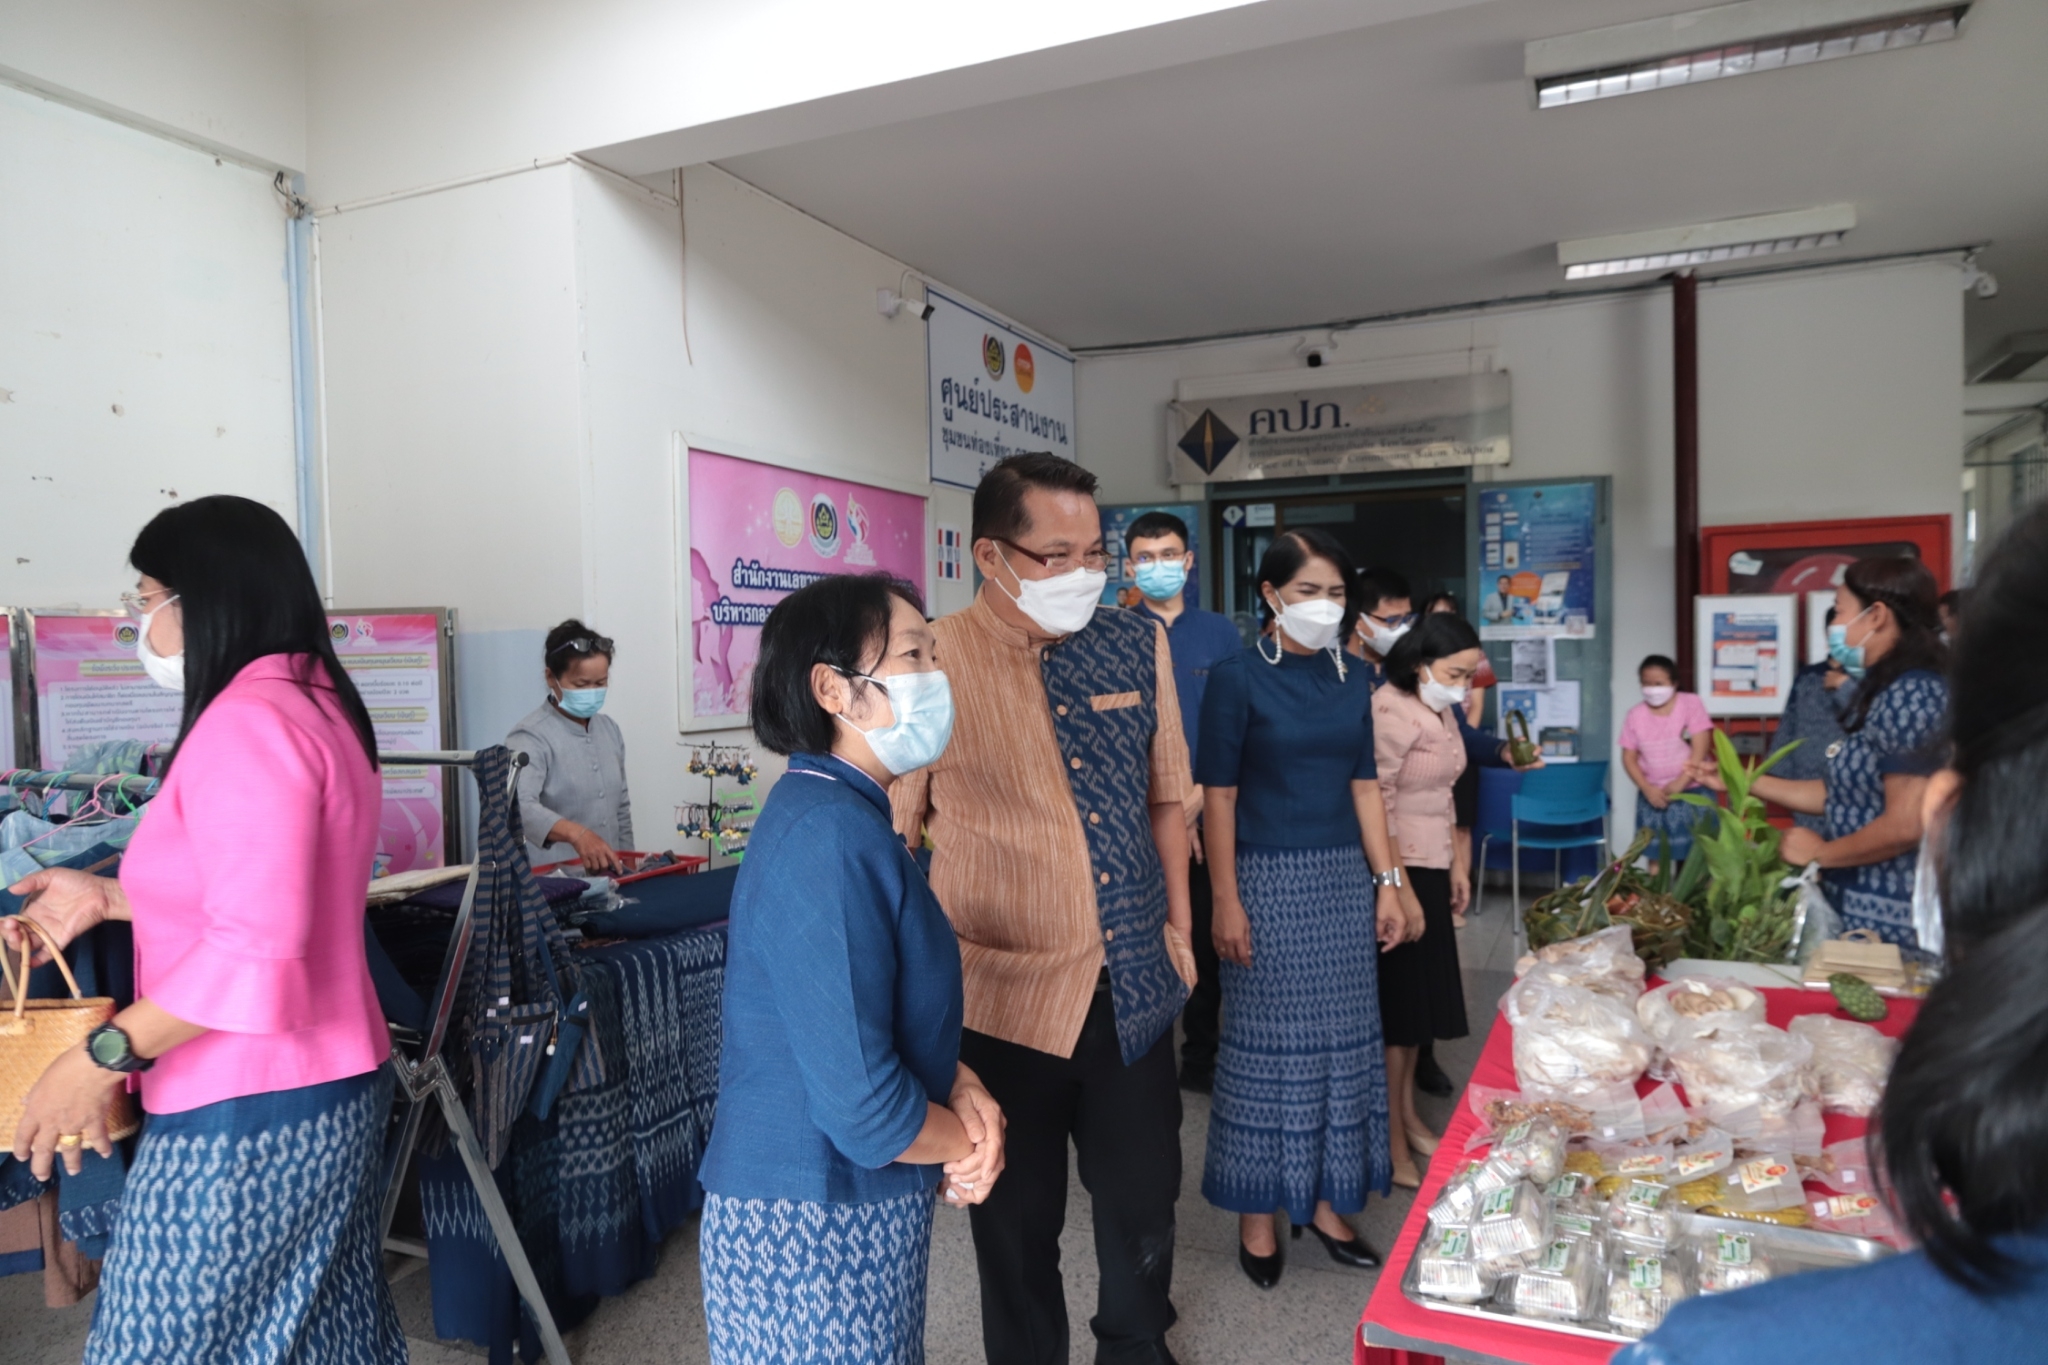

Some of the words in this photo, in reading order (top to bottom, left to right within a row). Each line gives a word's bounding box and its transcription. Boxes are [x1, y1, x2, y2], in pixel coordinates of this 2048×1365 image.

[941, 377, 1068, 445] ศูนย์ประสานงาน
[1248, 400, 1351, 435] คปภ.
